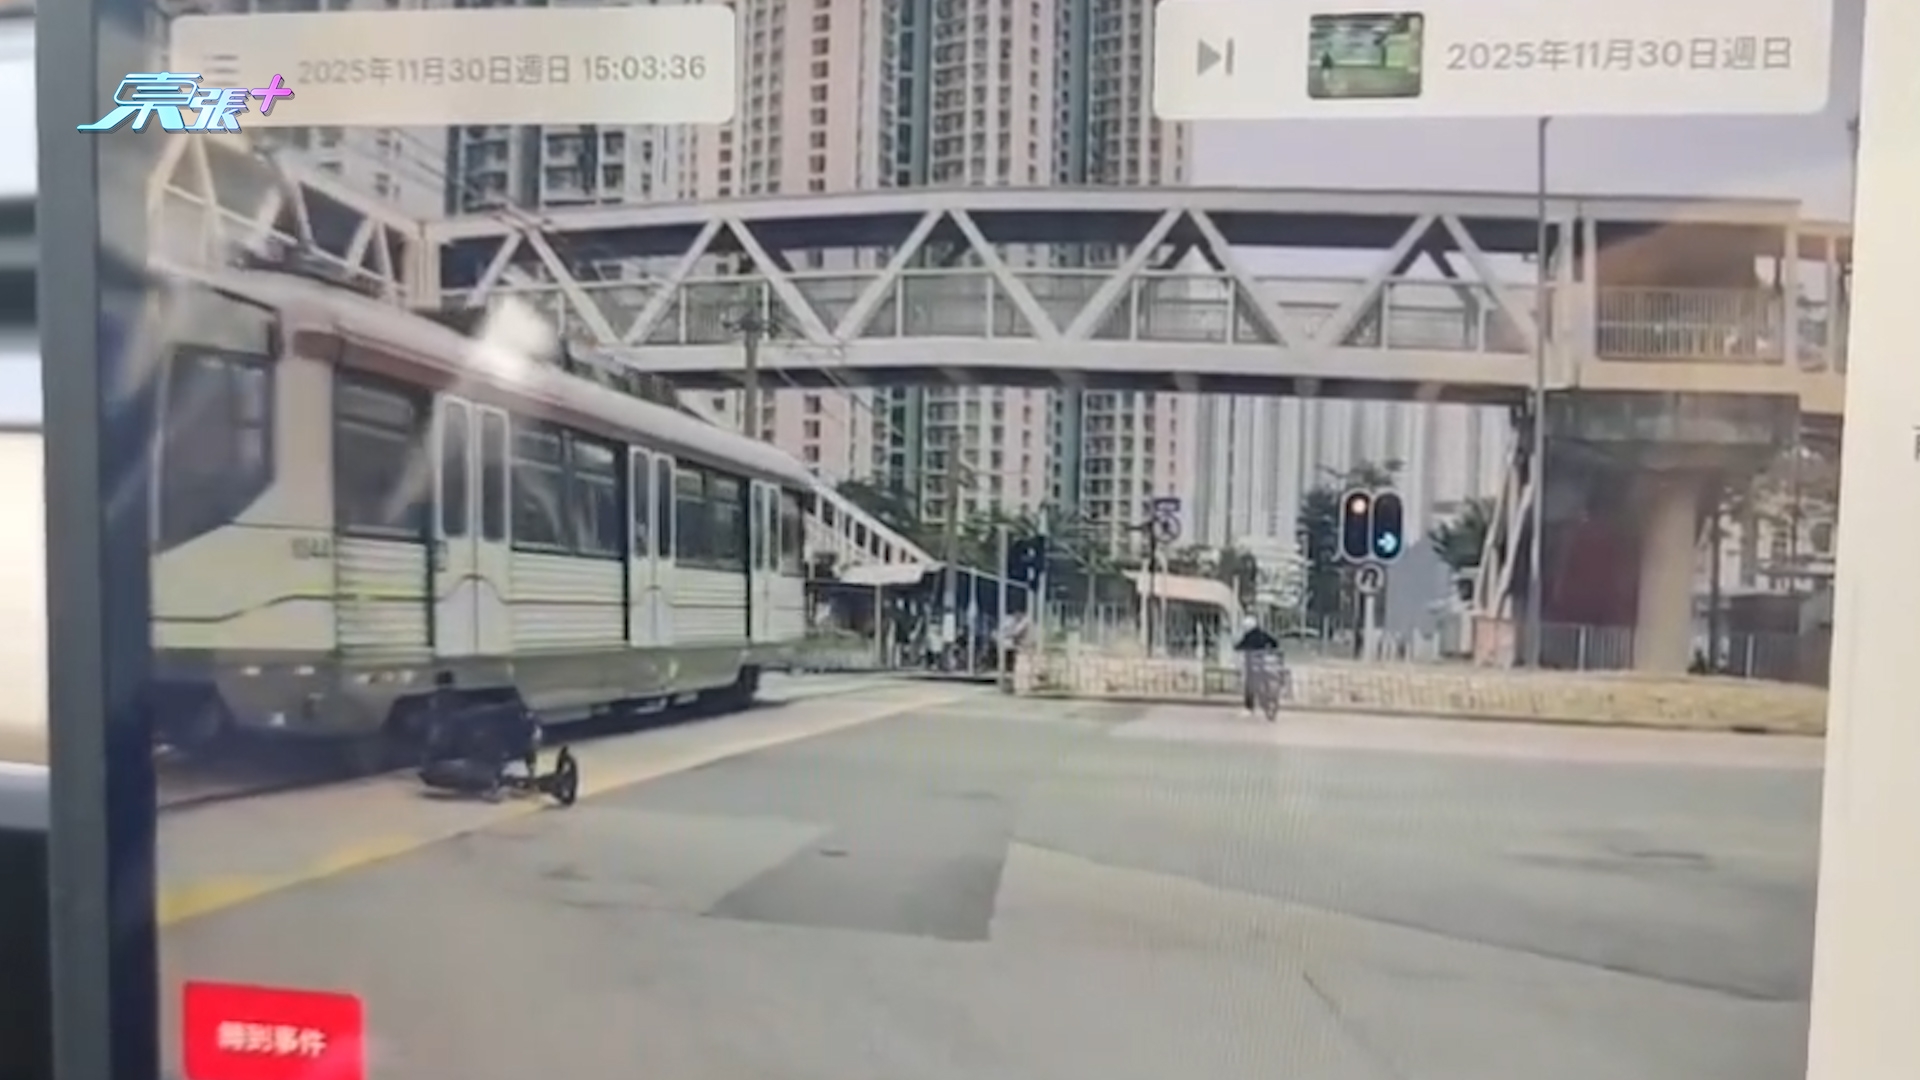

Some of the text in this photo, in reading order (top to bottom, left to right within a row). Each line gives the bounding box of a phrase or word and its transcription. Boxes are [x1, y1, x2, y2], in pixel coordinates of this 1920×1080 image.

[1446, 36, 1792, 71] 2025年11月30日週日
[297, 55, 707, 86] 2025年11月30日週日 15:03:36
